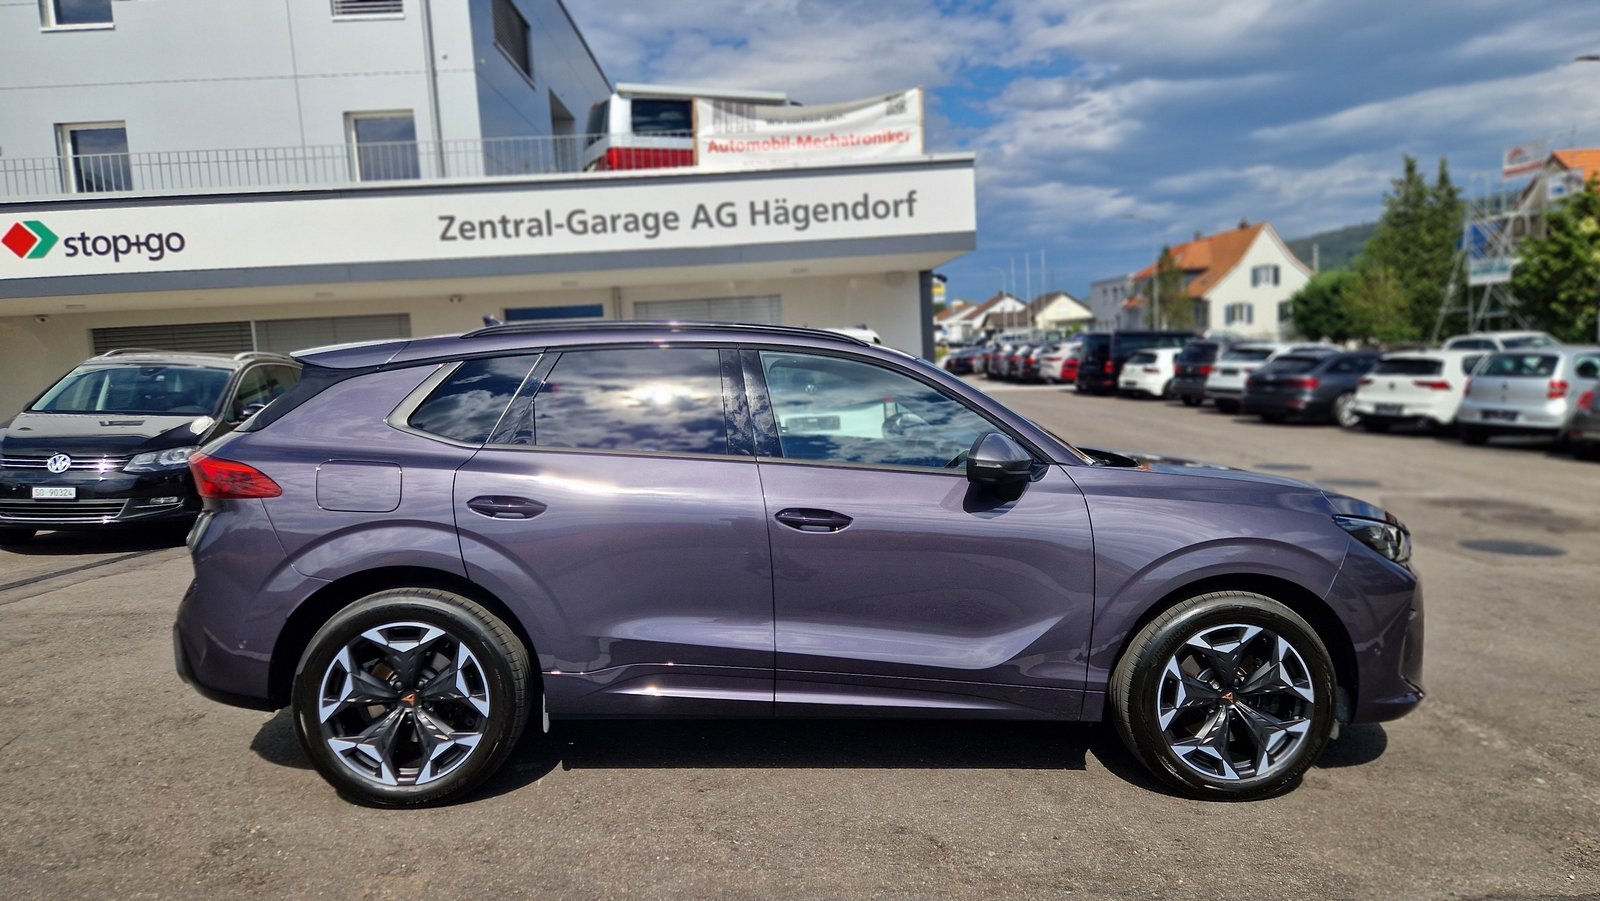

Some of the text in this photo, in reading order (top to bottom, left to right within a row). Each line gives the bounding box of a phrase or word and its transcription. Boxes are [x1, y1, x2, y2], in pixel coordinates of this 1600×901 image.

[707, 129, 911, 153] Automobil-Mechatroniker
[438, 190, 917, 241] Zentral-Garage AG Hägendorf
[63, 232, 186, 262] stop+go
[49, 488, 73, 497] 90324
